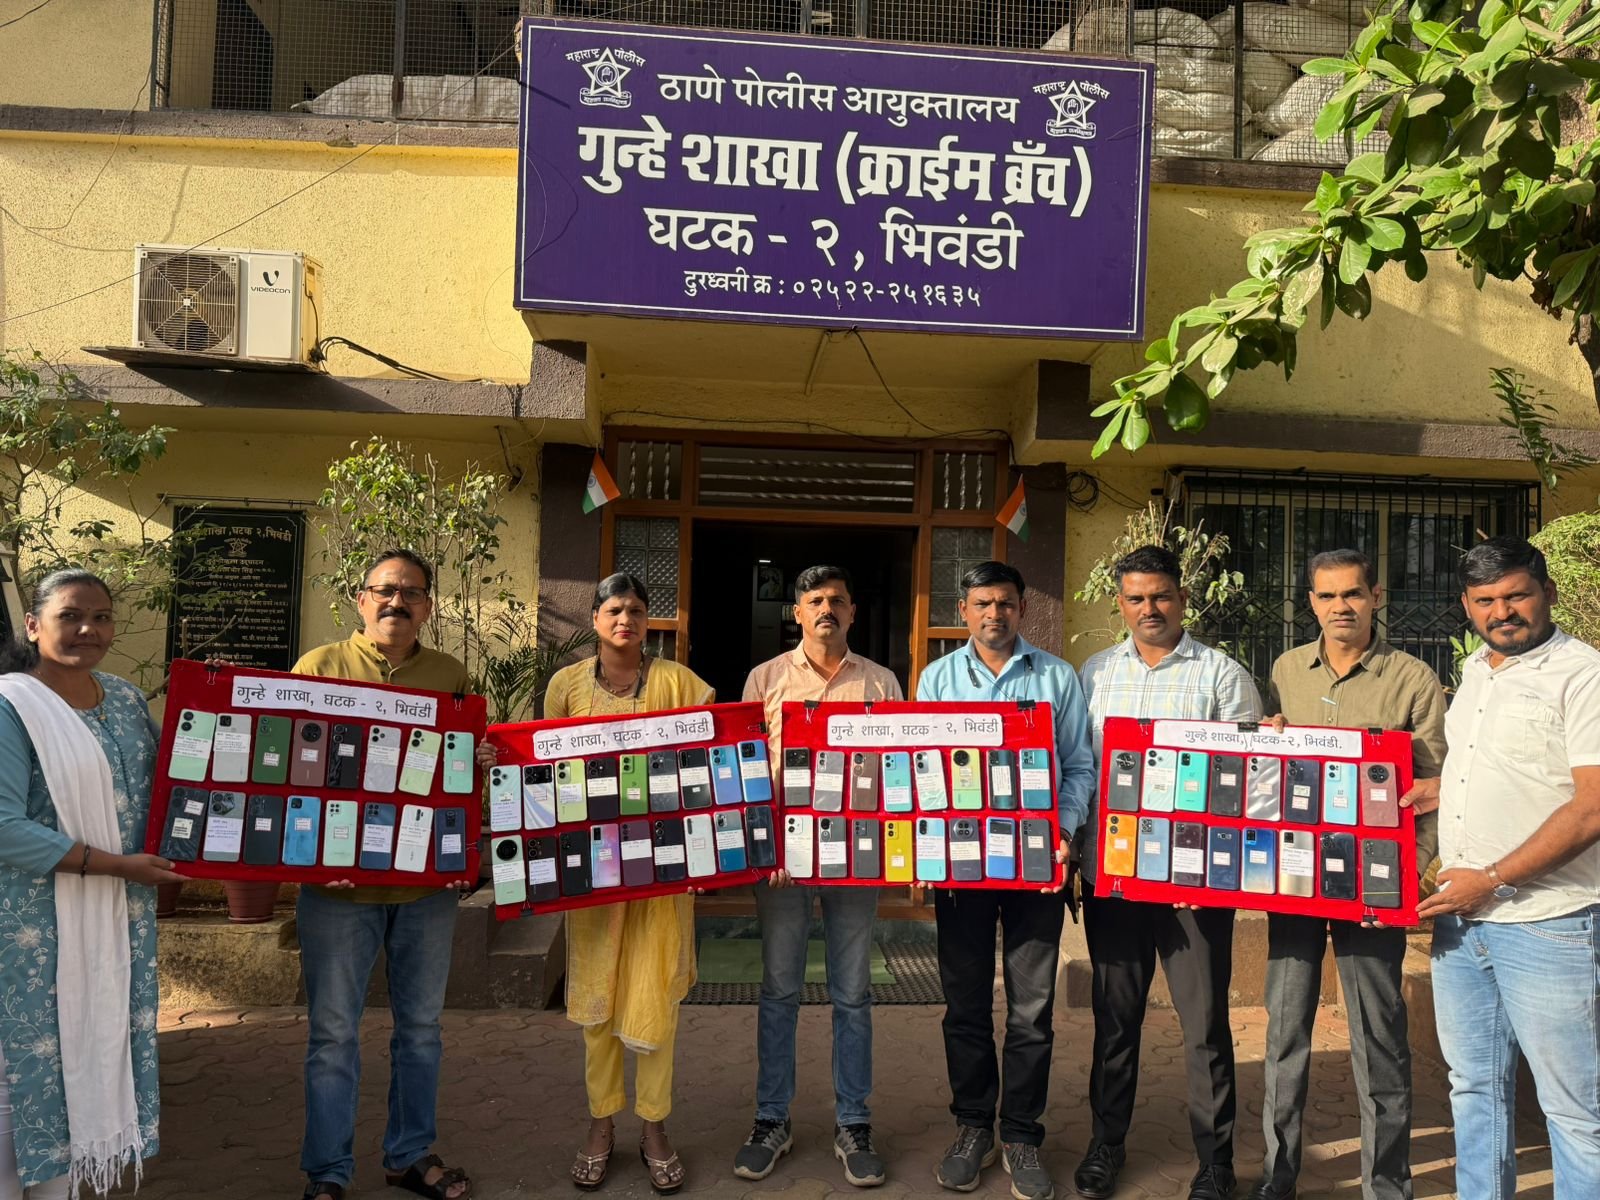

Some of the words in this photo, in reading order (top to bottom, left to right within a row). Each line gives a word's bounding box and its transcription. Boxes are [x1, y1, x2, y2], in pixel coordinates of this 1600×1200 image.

[614, 47, 646, 67] पोलीस
[658, 64, 726, 104] ठाणे
[732, 65, 838, 111] पोलीस
[842, 87, 1020, 127] आयुक्तालय
[1080, 80, 1110, 99] पोलीस
[578, 115, 672, 194] गुन्हे
[681, 134, 822, 191] शाखा
[836, 131, 996, 204] (क्राईम
[644, 207, 757, 255] घटक
[879, 206, 1025, 270] भिवंडी
[250, 286, 291, 294] VIDEOCON
[237, 683, 266, 704] गुन्हे
[276, 688, 314, 707] शाखा,
[324, 694, 357, 708] घटक
[394, 699, 432, 718] भिवंडी
[537, 735, 562, 756] गुन्हे
[570, 733, 606, 748] शाखा,
[613, 729, 643, 742] घटक
[675, 718, 709, 736] भिवंडी
[831, 722, 854, 740] गुन्हे
[861, 724, 895, 738] शाखा,
[902, 724, 930, 736] घटक
[964, 718, 998, 733] भिवंडी
[1185, 728, 1208, 743] गुन्हे
